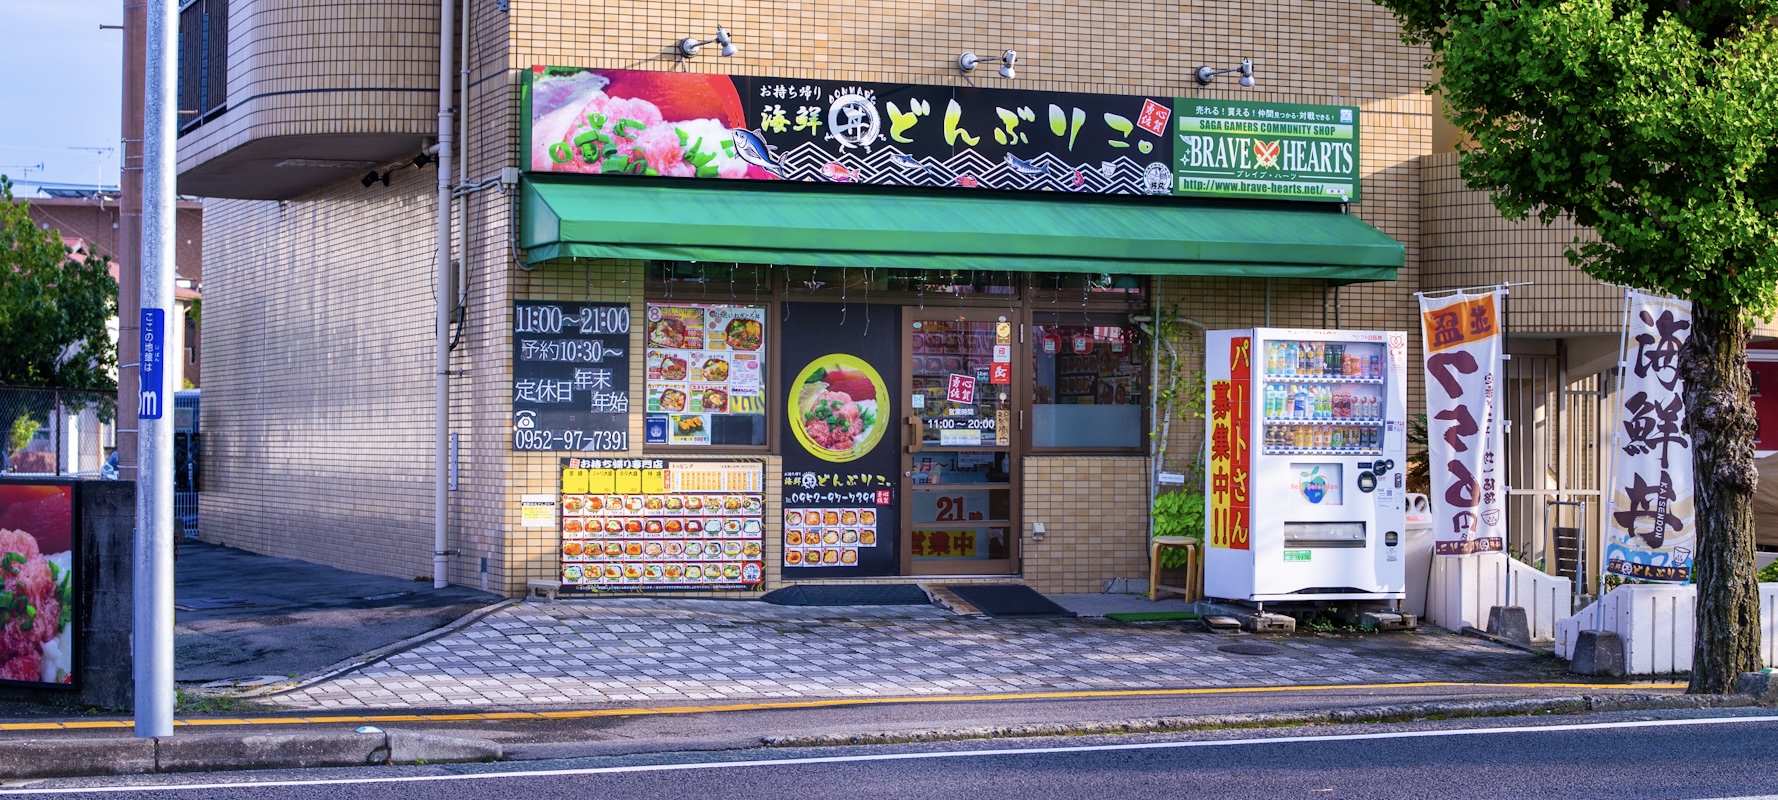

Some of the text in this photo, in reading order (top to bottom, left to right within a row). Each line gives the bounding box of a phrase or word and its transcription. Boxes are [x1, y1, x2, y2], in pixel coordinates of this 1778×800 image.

[760, 84, 822, 101] お持ち帰り
[761, 104, 823, 136] 海鮮
[1200, 120, 1335, 136] SAGA GAMERS COMMUNITY SHOP
[1190, 136, 1353, 174] BRAVE HEARTS
[1236, 170, 1297, 180] ブレイブ・ハーツ
[1184, 179, 1324, 195] http://www.brave-hearts.net/
[515, 306, 629, 333] 11:00～21:00
[144, 312, 154, 372] ここの地盤は
[521, 341, 623, 361] 予約10:30～
[574, 370, 611, 390] 年末
[515, 380, 572, 402] 定休日
[591, 391, 628, 412] 年始
[928, 420, 955, 429] 11:00
[968, 419, 995, 429] 20:00
[1614, 310, 1690, 549] 海鮮丼
[515, 431, 628, 450] 0952-97-7391
[1231, 339, 1250, 545] パートさん
[580, 459, 663, 469] お持ち帰り専門店
[1655, 481, 1668, 538] KAISENDON
[912, 531, 974, 556] 営業中
